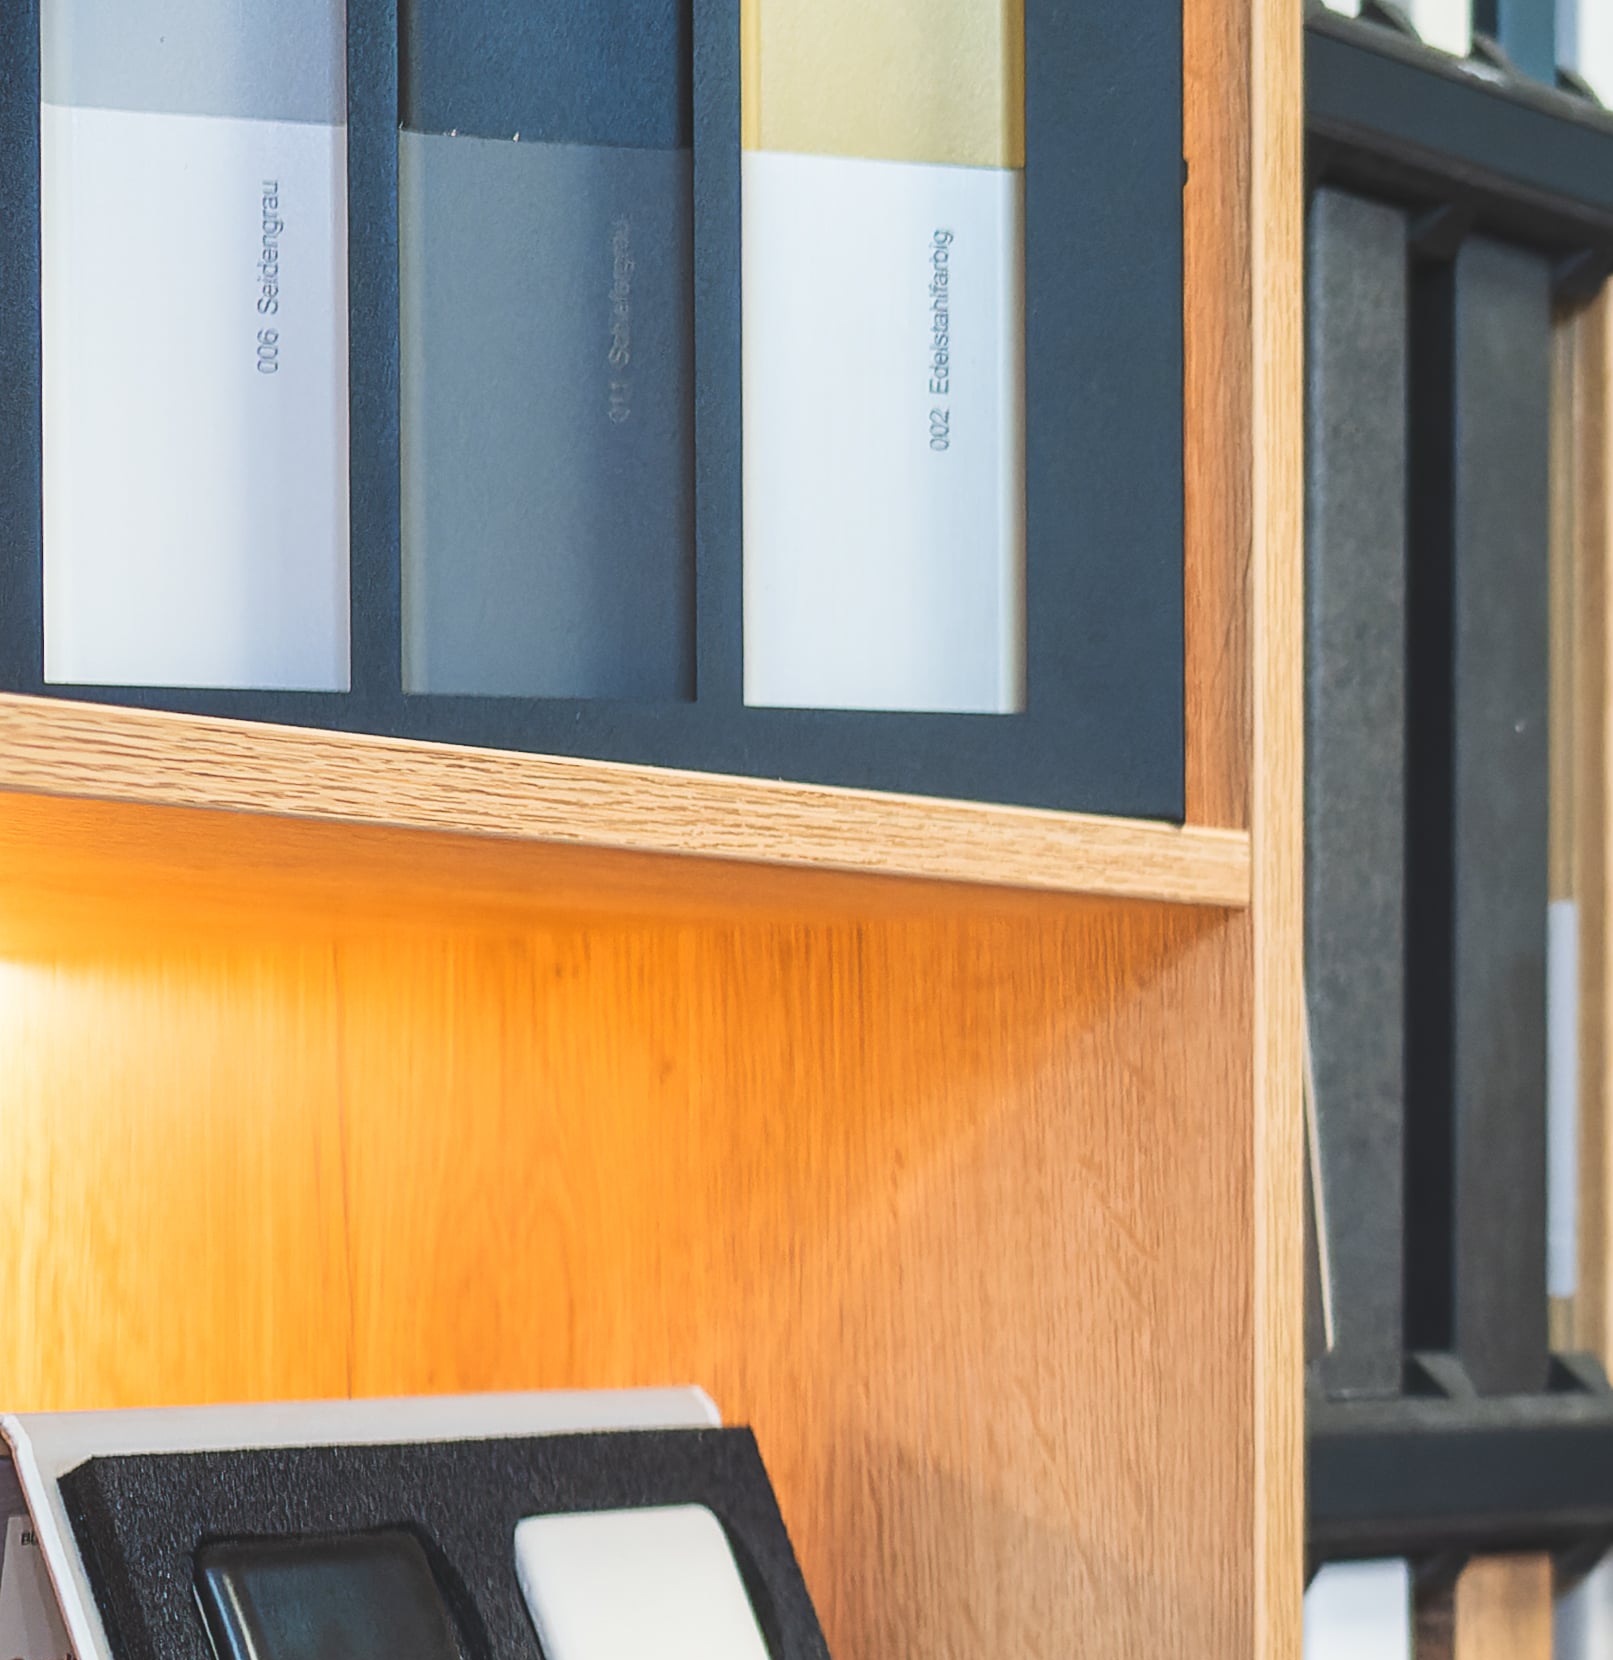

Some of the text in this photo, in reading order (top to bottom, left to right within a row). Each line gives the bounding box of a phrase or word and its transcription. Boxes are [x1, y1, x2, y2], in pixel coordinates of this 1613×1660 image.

[256, 179, 284, 375] 006 Seidengrau
[928, 229, 954, 452] 002 Edelstahlfarbig
